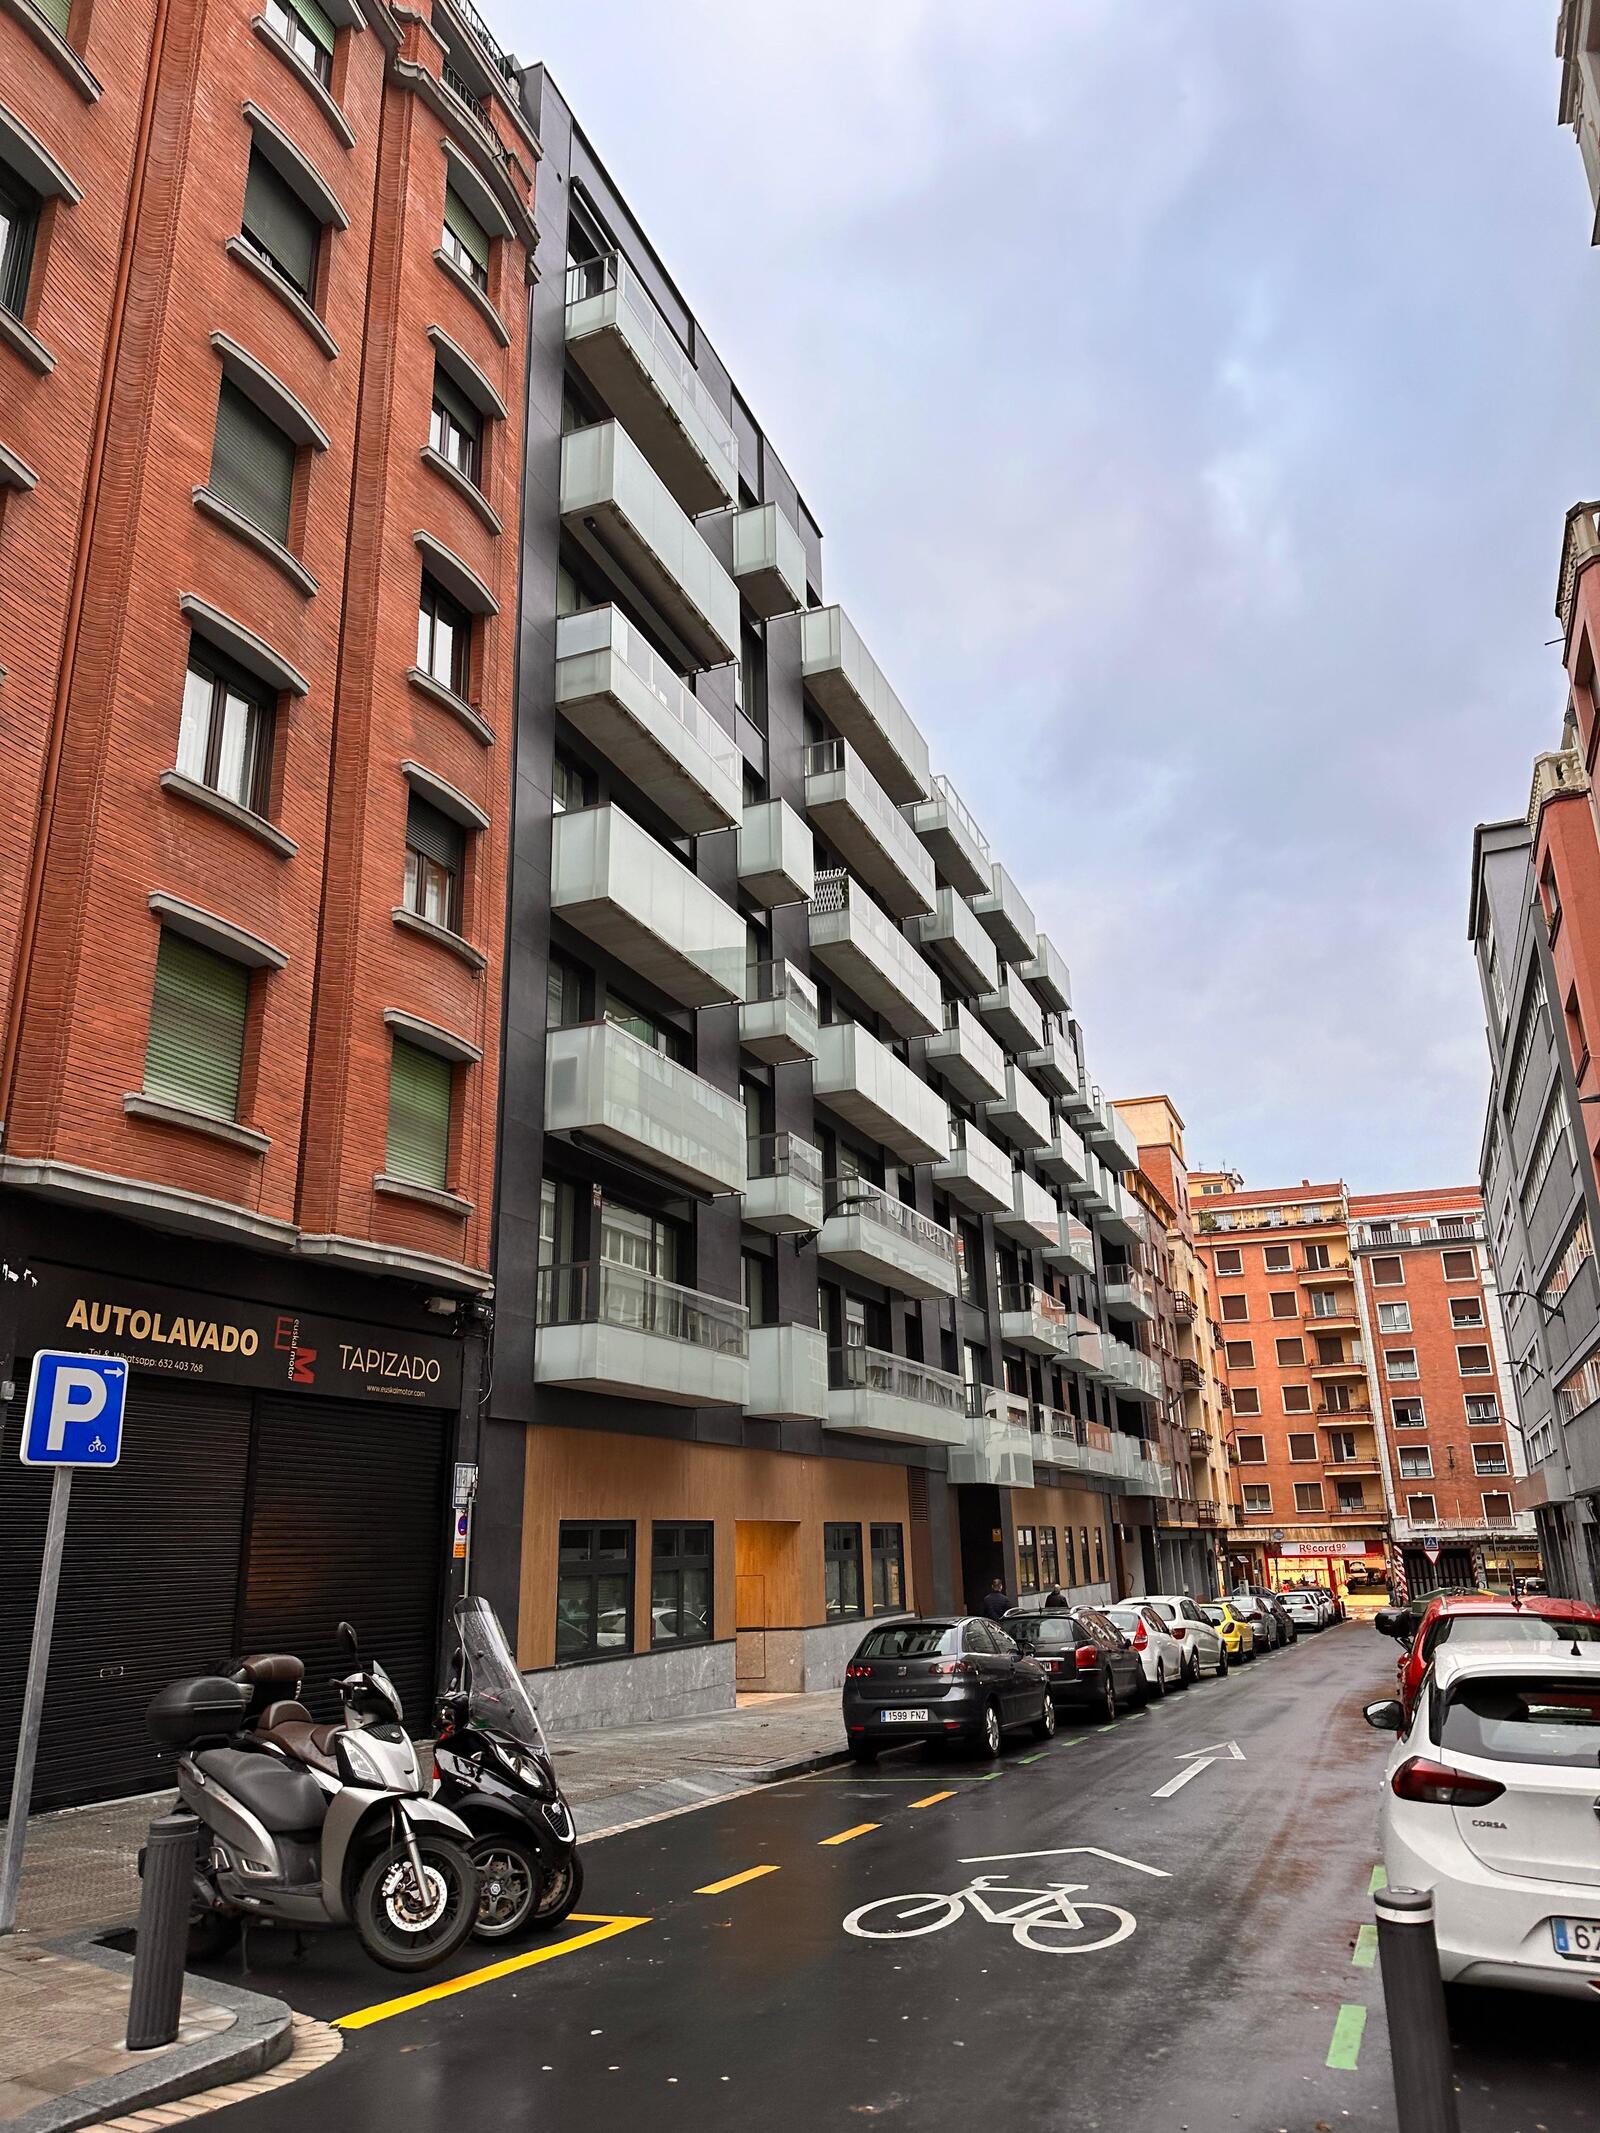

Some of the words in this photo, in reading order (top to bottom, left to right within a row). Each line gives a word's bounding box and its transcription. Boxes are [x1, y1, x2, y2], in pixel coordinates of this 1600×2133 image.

[66, 1299, 259, 1356] AUTOLAVADO
[291, 1319, 300, 1349] euskal
[158, 1359, 173, 1369] 632
[174, 1360, 189, 1371] 403
[190, 1362, 204, 1373] 768
[287, 1350, 296, 1381] motor
[339, 1344, 441, 1383] TAPIZADO
[366, 1385, 426, 1397] www.euskalmotor.com
[46, 1366, 107, 1451] P
[889, 1711, 908, 1721] 1599
[910, 1710, 926, 1720] FNZ
[1472, 1819, 1507, 1830] CORSA
